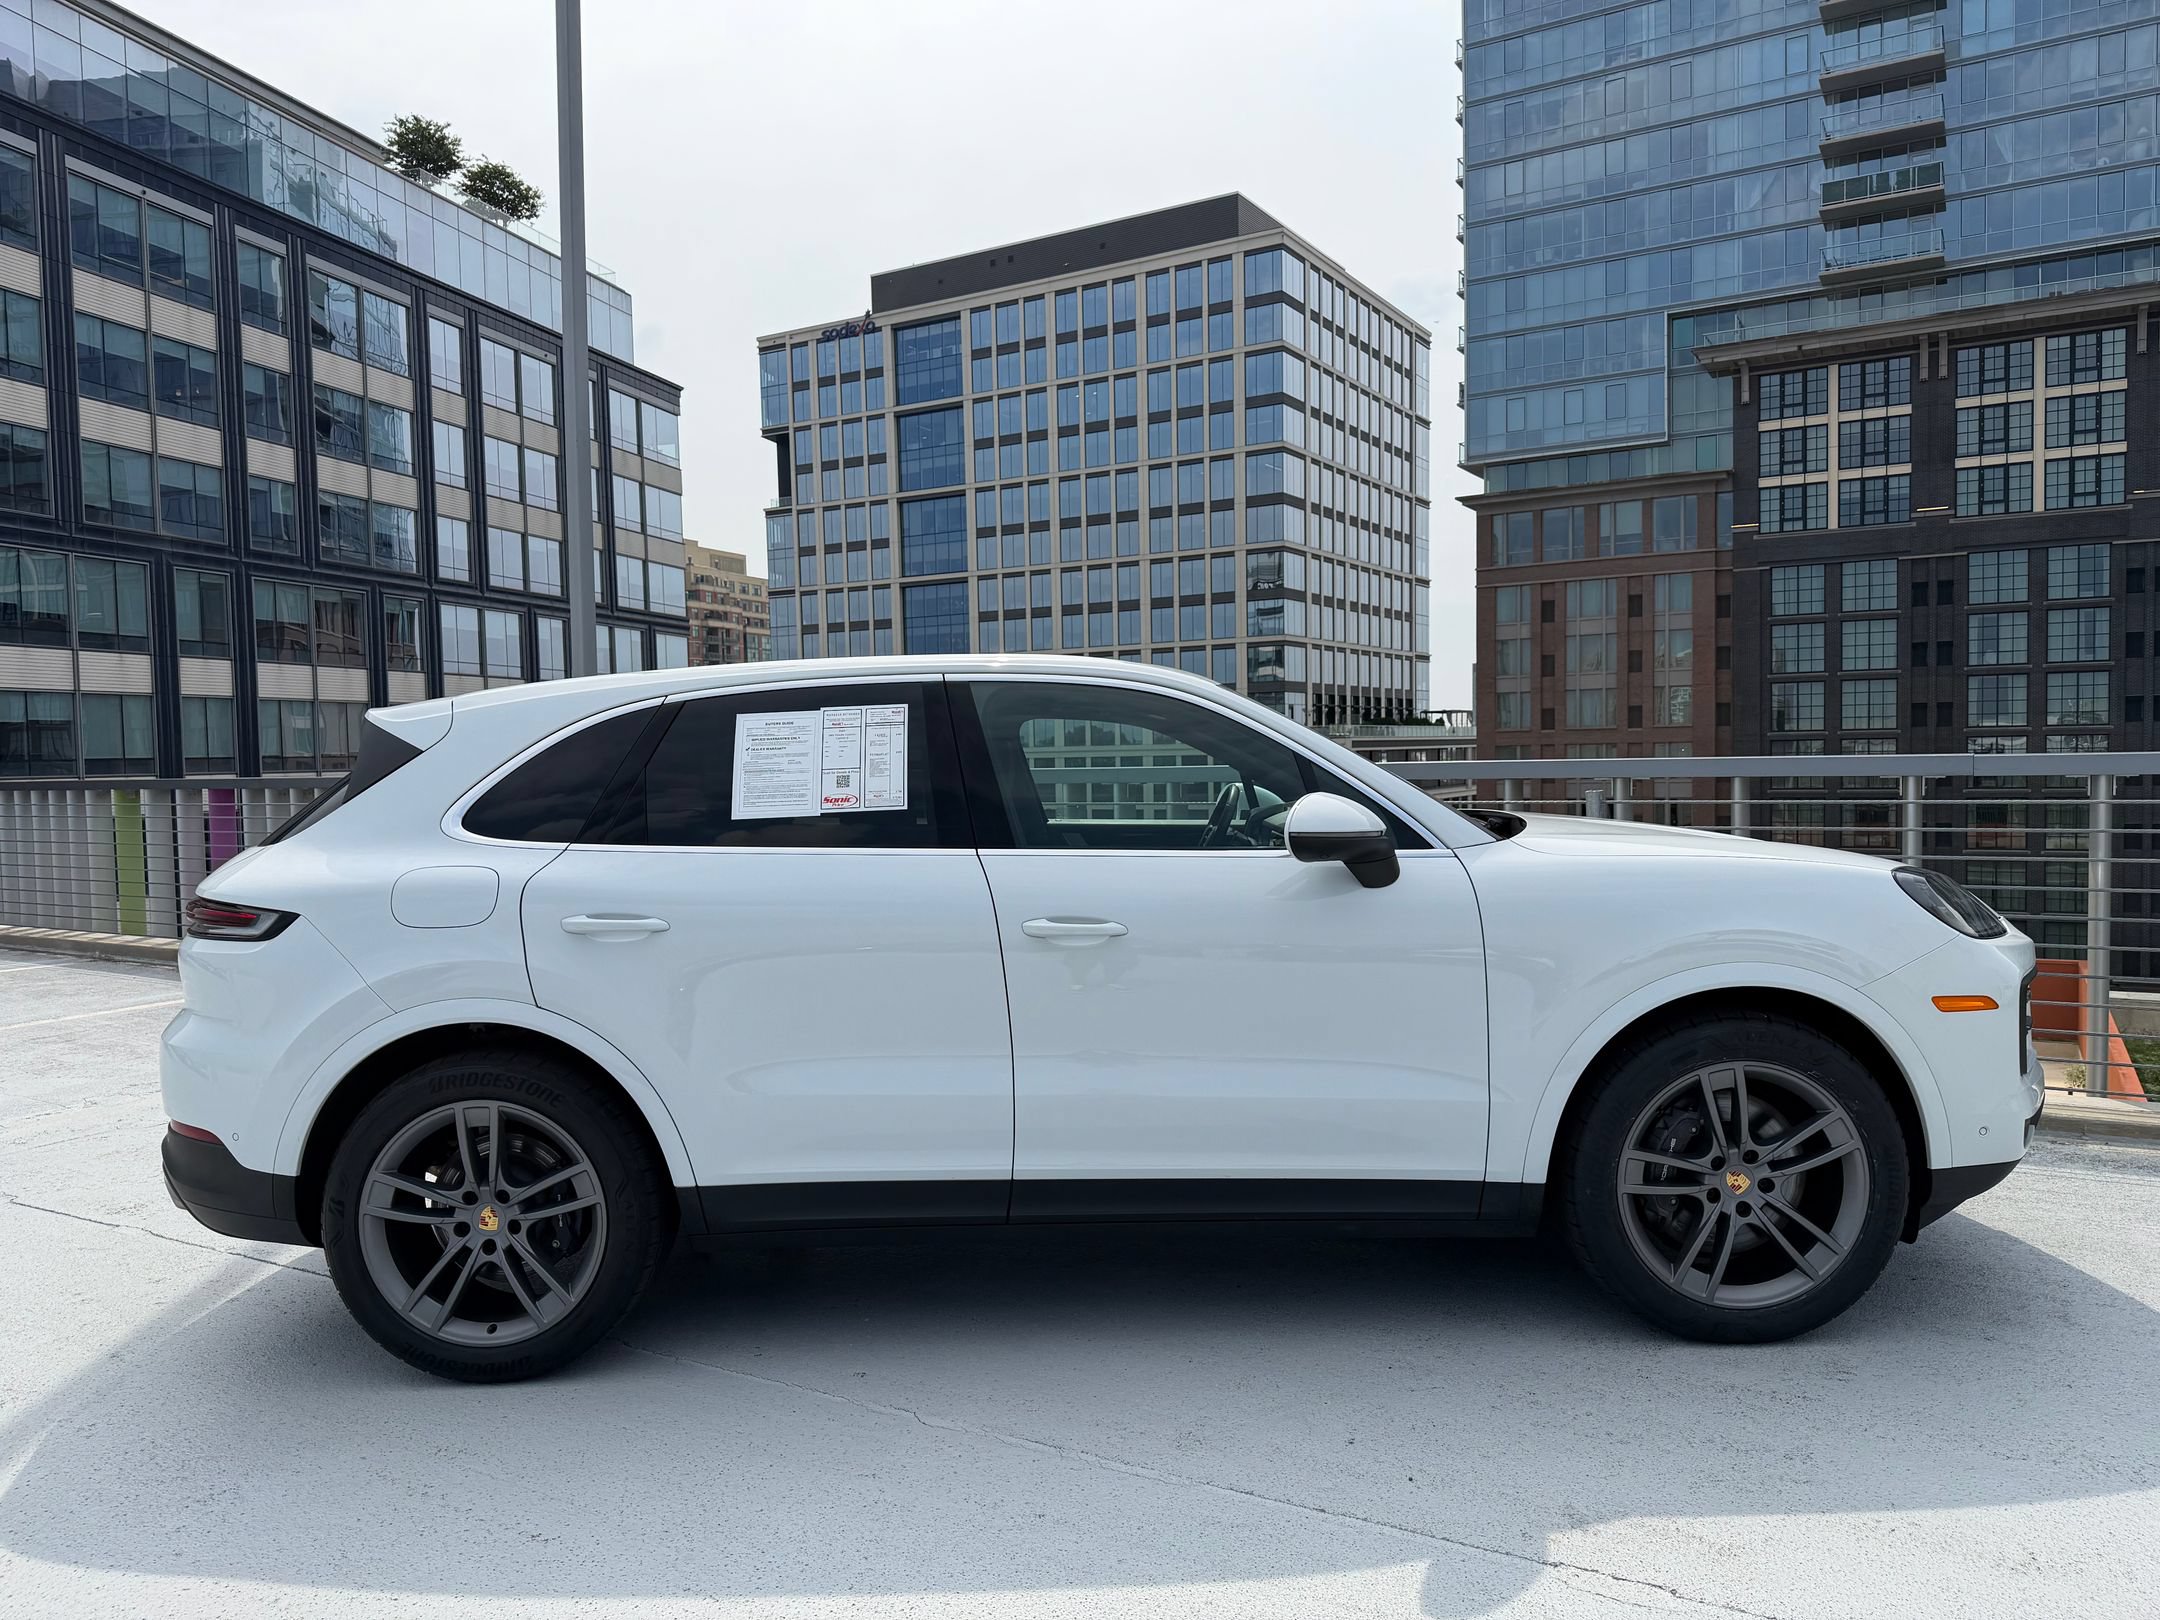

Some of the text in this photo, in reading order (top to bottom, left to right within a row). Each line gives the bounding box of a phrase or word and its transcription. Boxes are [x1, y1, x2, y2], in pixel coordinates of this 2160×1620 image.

[821, 314, 876, 341] sodexo
[823, 795, 854, 804] Sonic
[428, 1070, 566, 1108] BRIDGESTONE
